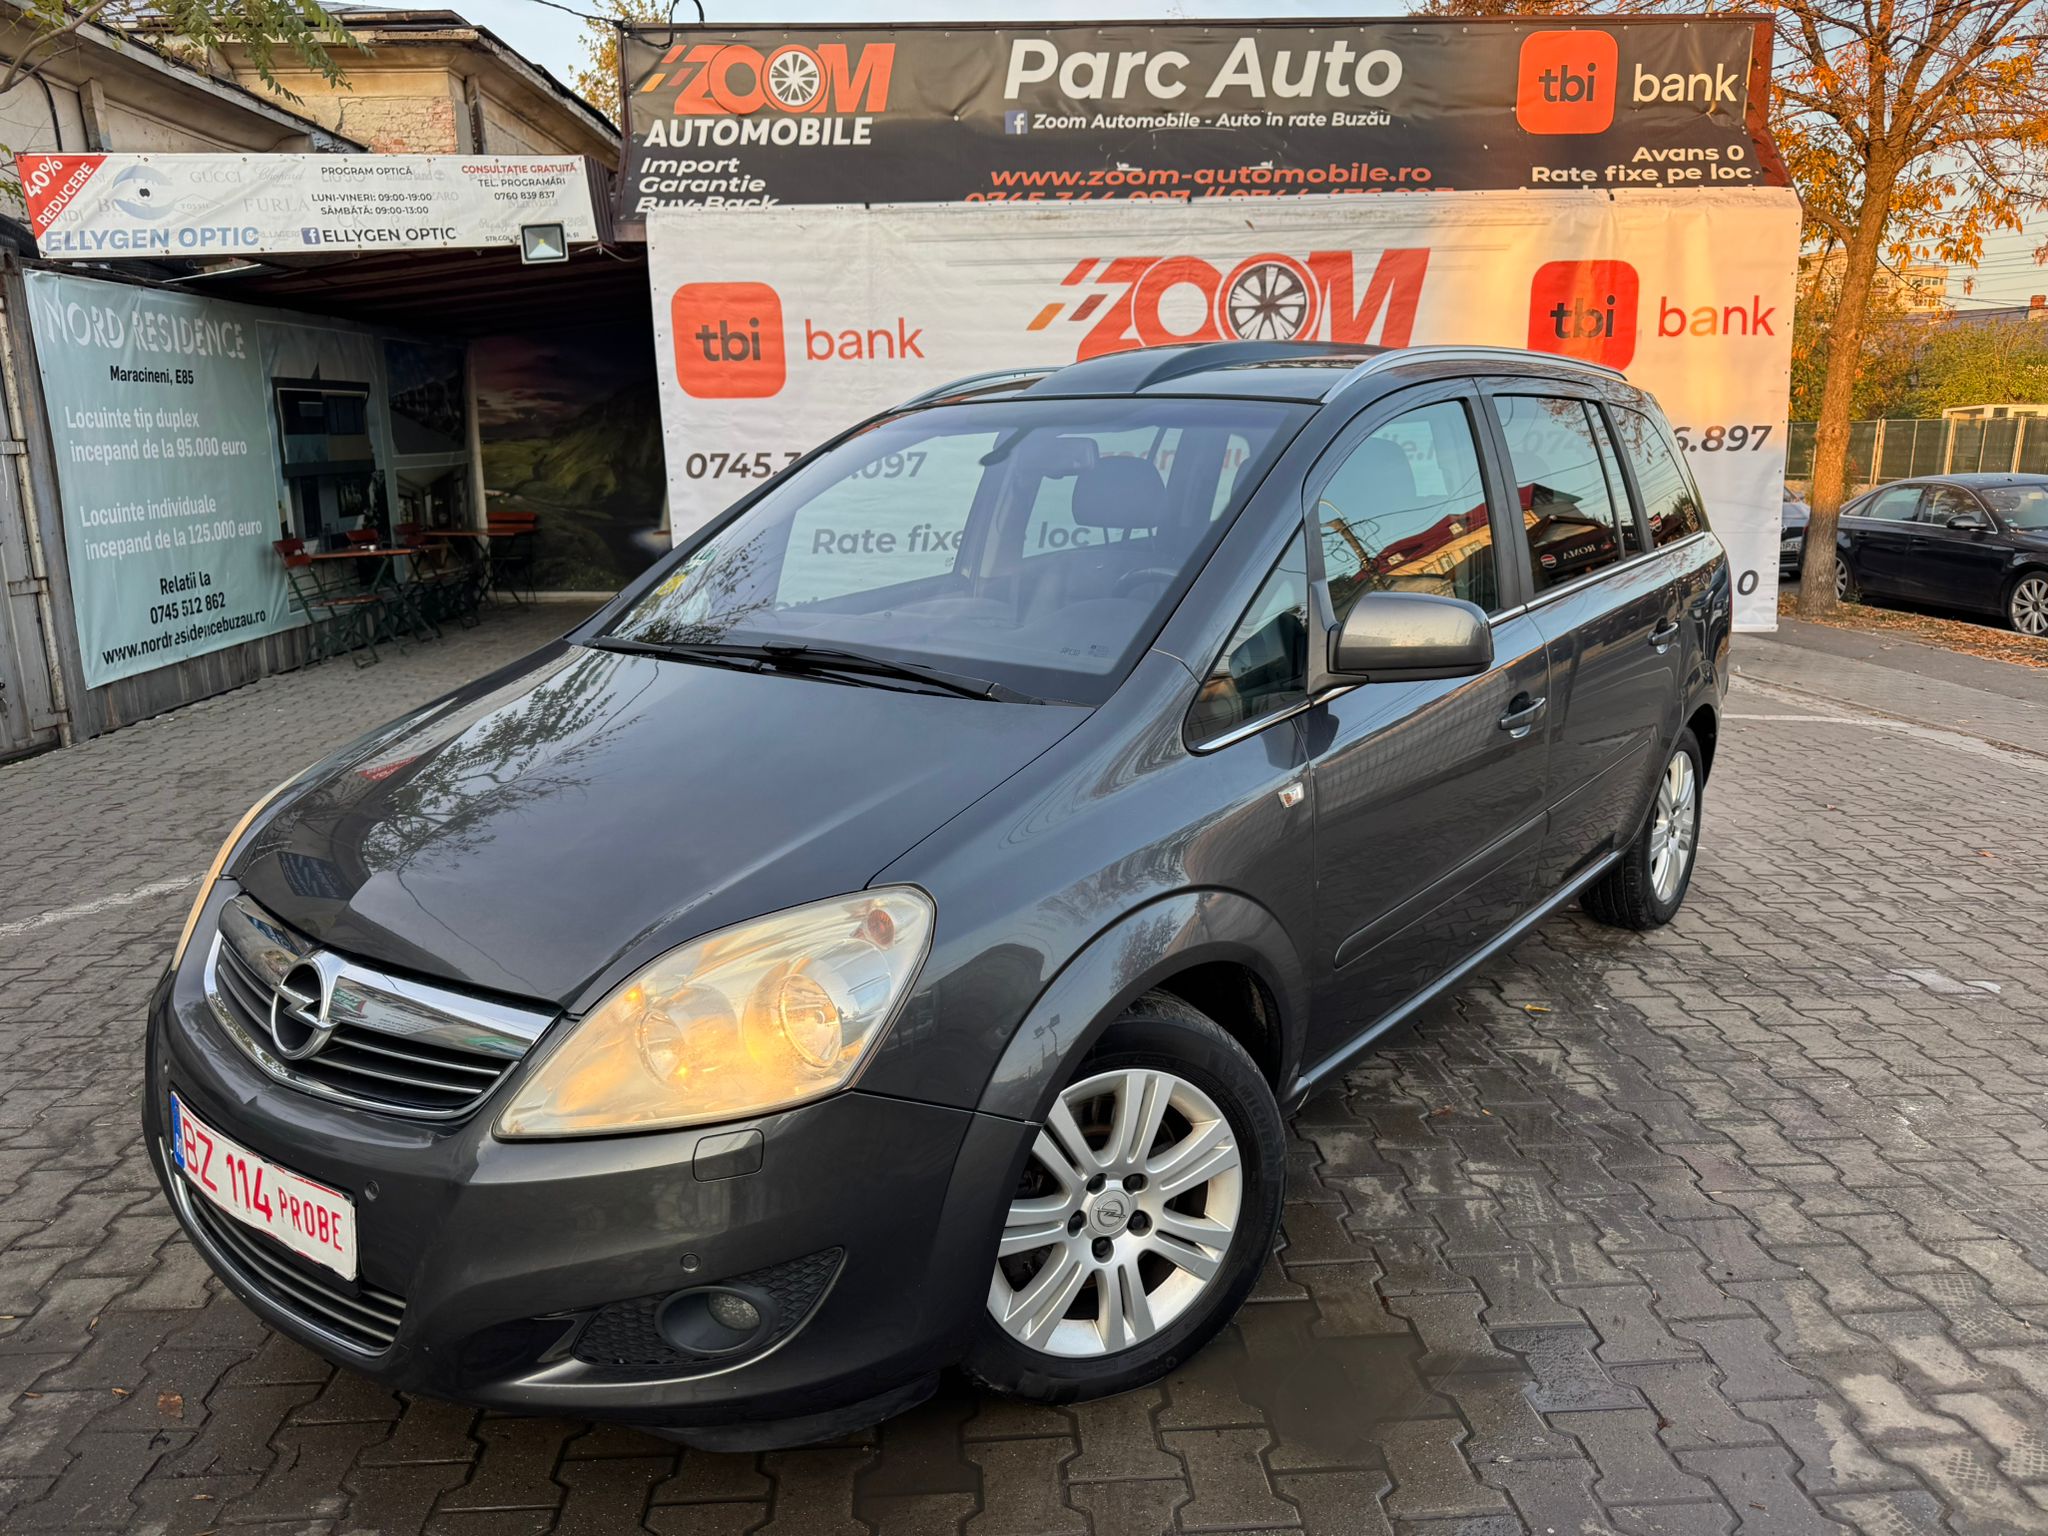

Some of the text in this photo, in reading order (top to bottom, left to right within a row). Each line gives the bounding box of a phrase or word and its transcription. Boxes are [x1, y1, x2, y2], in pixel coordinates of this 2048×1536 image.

[674, 43, 895, 114] ZOOM
[1004, 37, 1403, 100] Parc Auto
[1538, 63, 1596, 103] tbi
[1632, 63, 1738, 103] bank
[643, 116, 873, 149] AUTOMOBILE
[1033, 112, 1089, 131] Zoom
[1091, 112, 1201, 130] Automobile
[1216, 112, 1262, 128] Auto
[1266, 111, 1284, 127] in
[1288, 112, 1328, 127] rate
[1331, 110, 1391, 127] Buzău
[640, 156, 740, 177] Import
[1631, 144, 1745, 163] Avans 0
[24, 156, 63, 198] 40%
[321, 167, 374, 176] PROGRAM
[478, 179, 499, 188] TEL.
[638, 174, 767, 194] Garantie
[990, 163, 1433, 188] www.zoom-automobile.ro
[1531, 163, 1753, 186] Rate fixe pe loc
[36, 162, 95, 227] REDUCERE
[311, 193, 377, 202] LUNI-VINERI:
[378, 193, 433, 202] 09:00-19:00
[494, 191, 555, 200] 0760 839 837
[375, 206, 429, 215] 09:00-13:00
[45, 226, 260, 252] ELLYGEN OPTIC
[322, 228, 401, 243] ELLYGEN
[405, 226, 457, 241] OPTIC
[42, 299, 246, 360] NORD RESIDENCE
[1549, 294, 1617, 338] tbi
[1658, 296, 1775, 337] bank
[695, 317, 761, 362] tbi
[805, 318, 925, 361] bank
[110, 365, 194, 387] Maracineni, E85
[66, 405, 201, 430] Locuinte tip duplex
[71, 437, 248, 466] incepand de la 95.000 euro
[80, 497, 217, 528] Locuinte individuale
[85, 519, 263, 562] incepand de la 125.000 euro
[812, 528, 897, 555] Rate
[1037, 522, 1092, 549] loc
[159, 571, 211, 596] Relatii la
[1737, 569, 1760, 596] 0
[150, 591, 226, 625] 0745 512 862
[181, 1116, 344, 1252] BZ 114 PROBE
